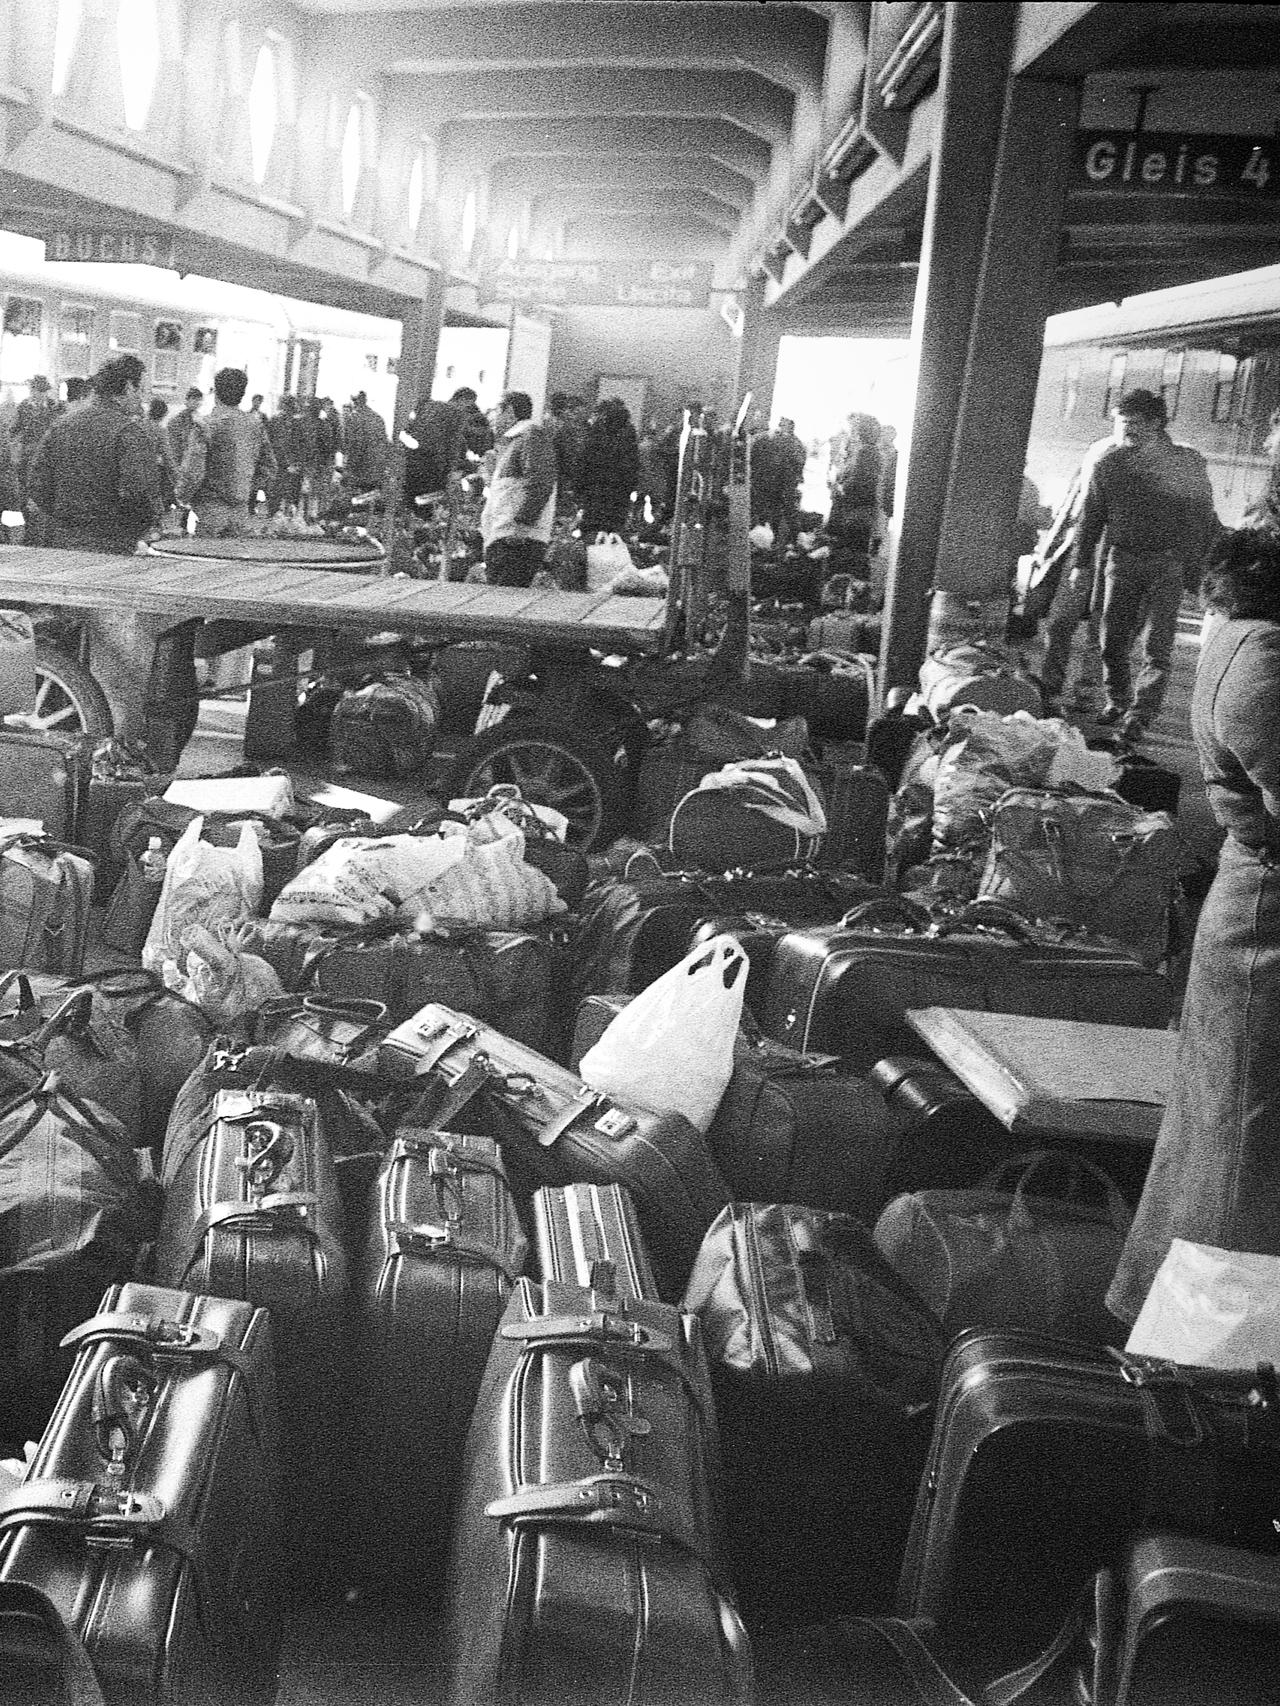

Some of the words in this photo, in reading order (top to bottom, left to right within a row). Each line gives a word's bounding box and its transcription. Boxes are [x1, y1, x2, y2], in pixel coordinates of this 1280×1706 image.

[1085, 140, 1219, 185] Gleis
[1240, 145, 1271, 189] 4
[56, 232, 158, 262] BUCHS
